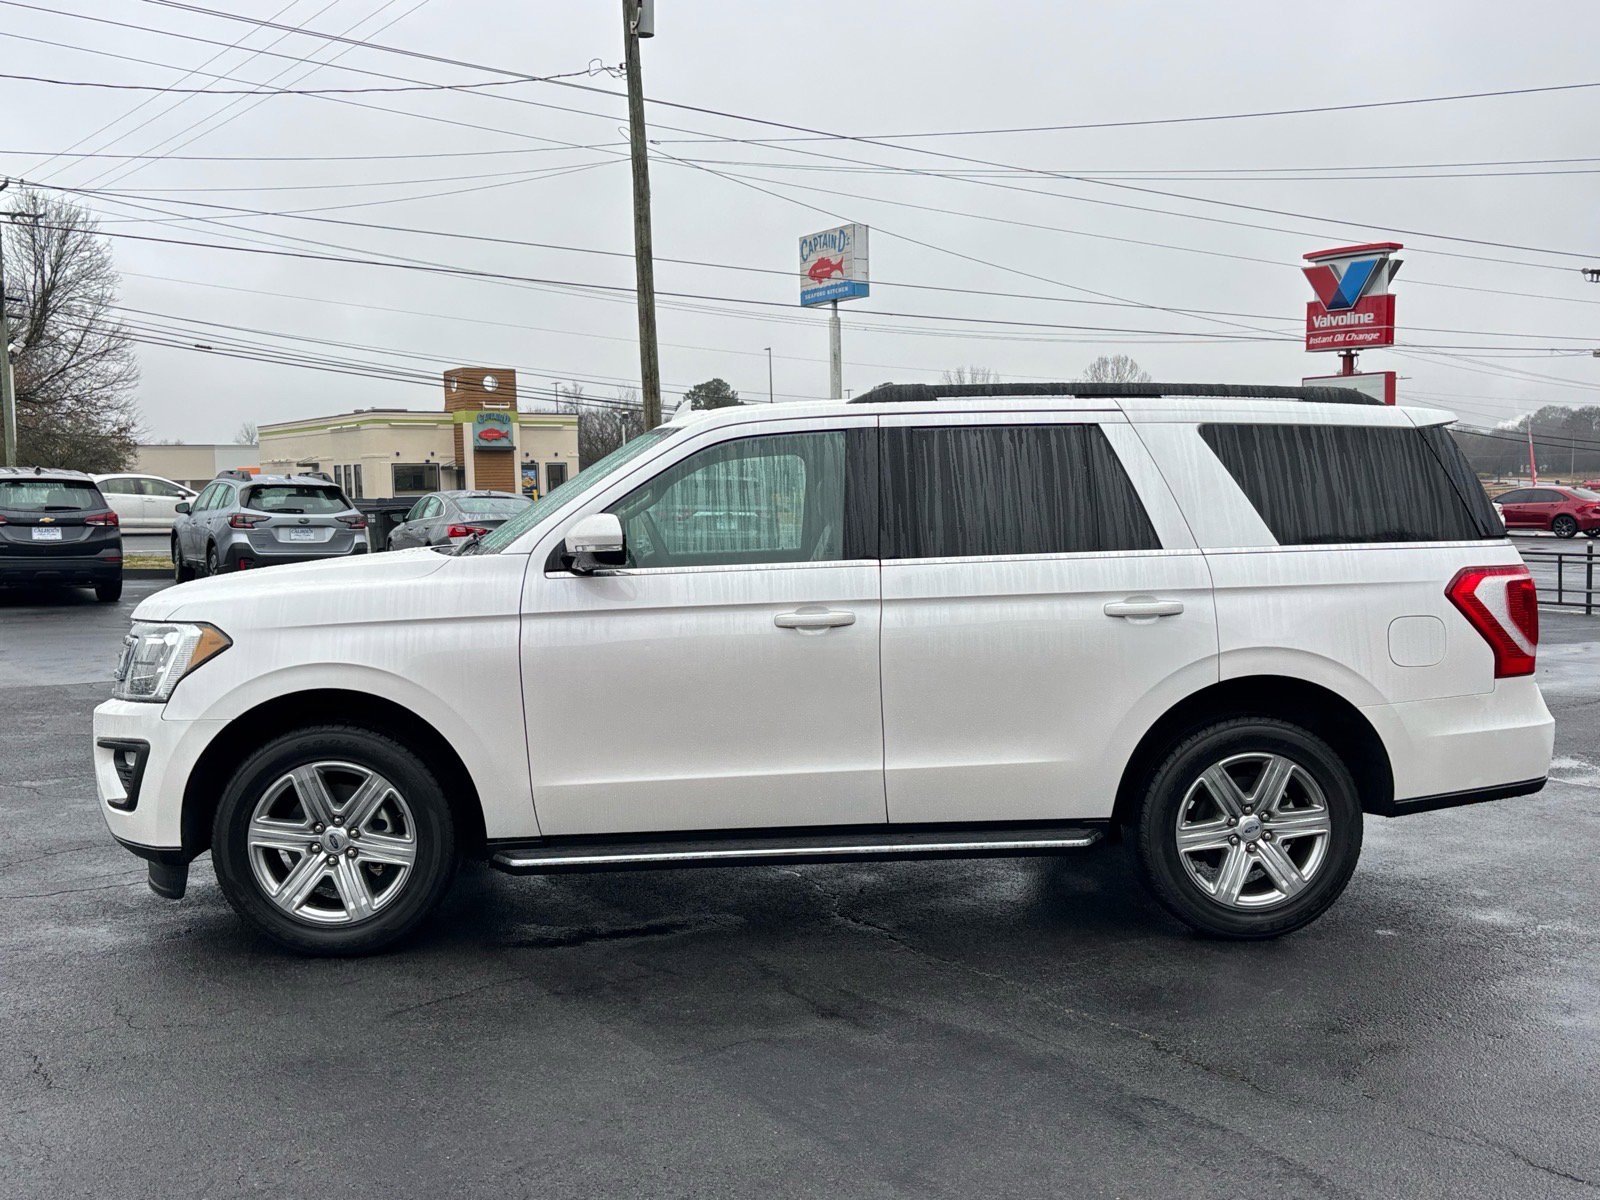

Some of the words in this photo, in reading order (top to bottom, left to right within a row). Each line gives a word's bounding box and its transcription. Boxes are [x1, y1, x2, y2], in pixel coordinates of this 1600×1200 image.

[800, 233, 837, 262] CAPTAIN
[804, 290, 826, 300] SEAFOOD
[826, 286, 849, 295] KITCHEN
[1312, 311, 1375, 329] Valvoline
[1308, 336, 1333, 345] Instant
[1333, 334, 1345, 342] Oil
[1345, 332, 1380, 342] Change
